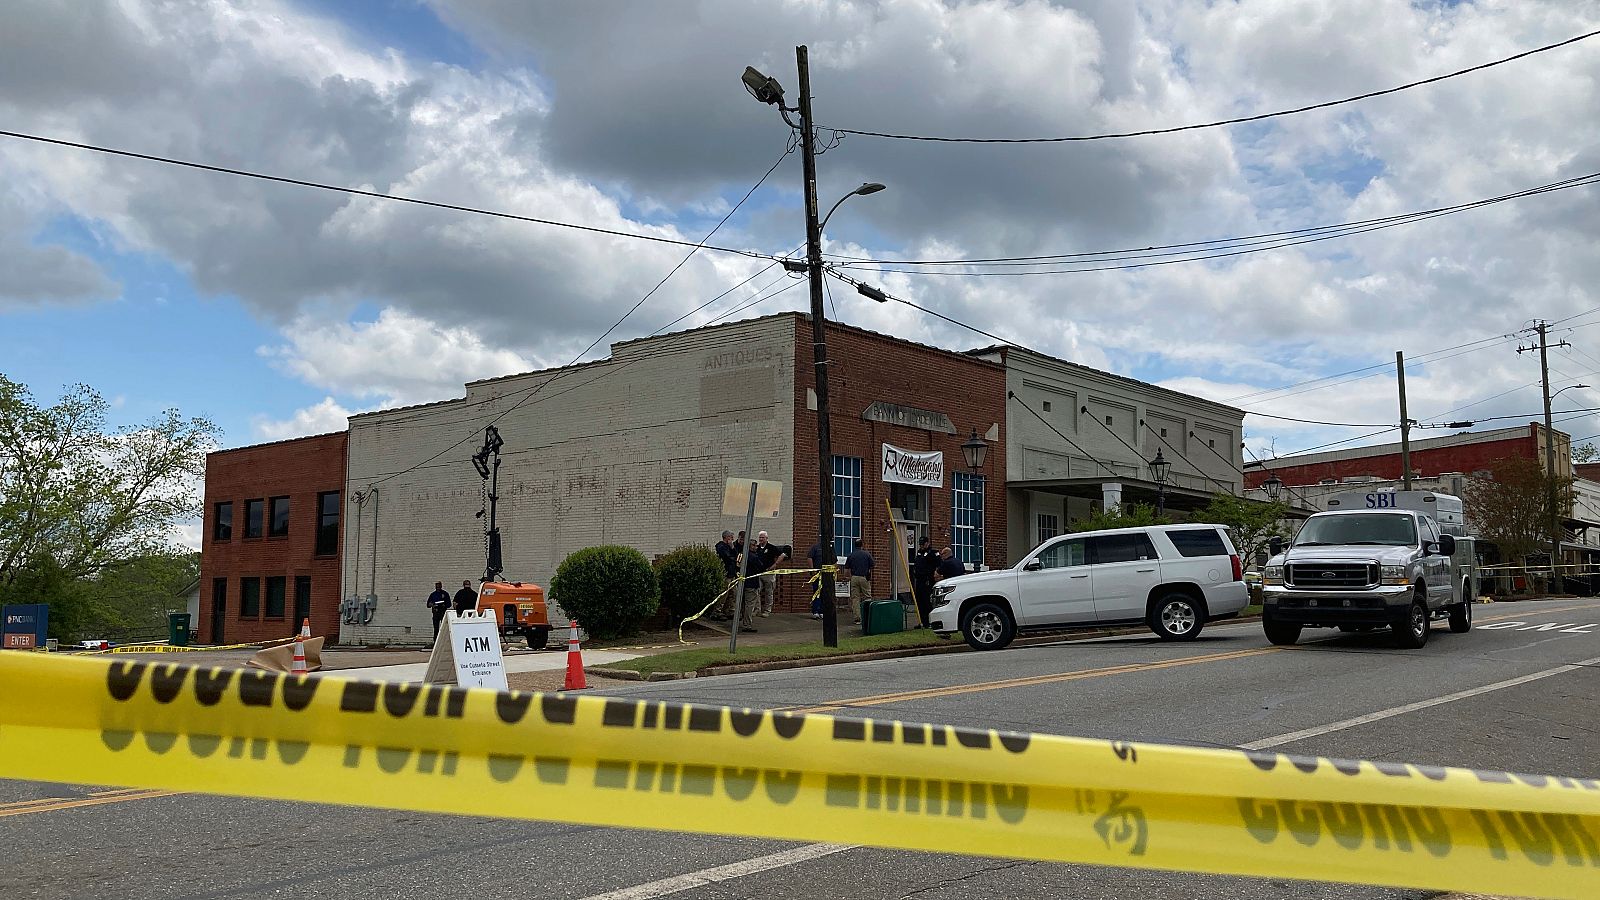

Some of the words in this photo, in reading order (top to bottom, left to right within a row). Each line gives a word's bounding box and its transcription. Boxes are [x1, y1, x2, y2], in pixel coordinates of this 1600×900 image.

[704, 349, 772, 370] ANTIQUES
[1365, 492, 1397, 509] SBI
[11, 636, 30, 646] ENTER
[465, 636, 490, 652] ATM
